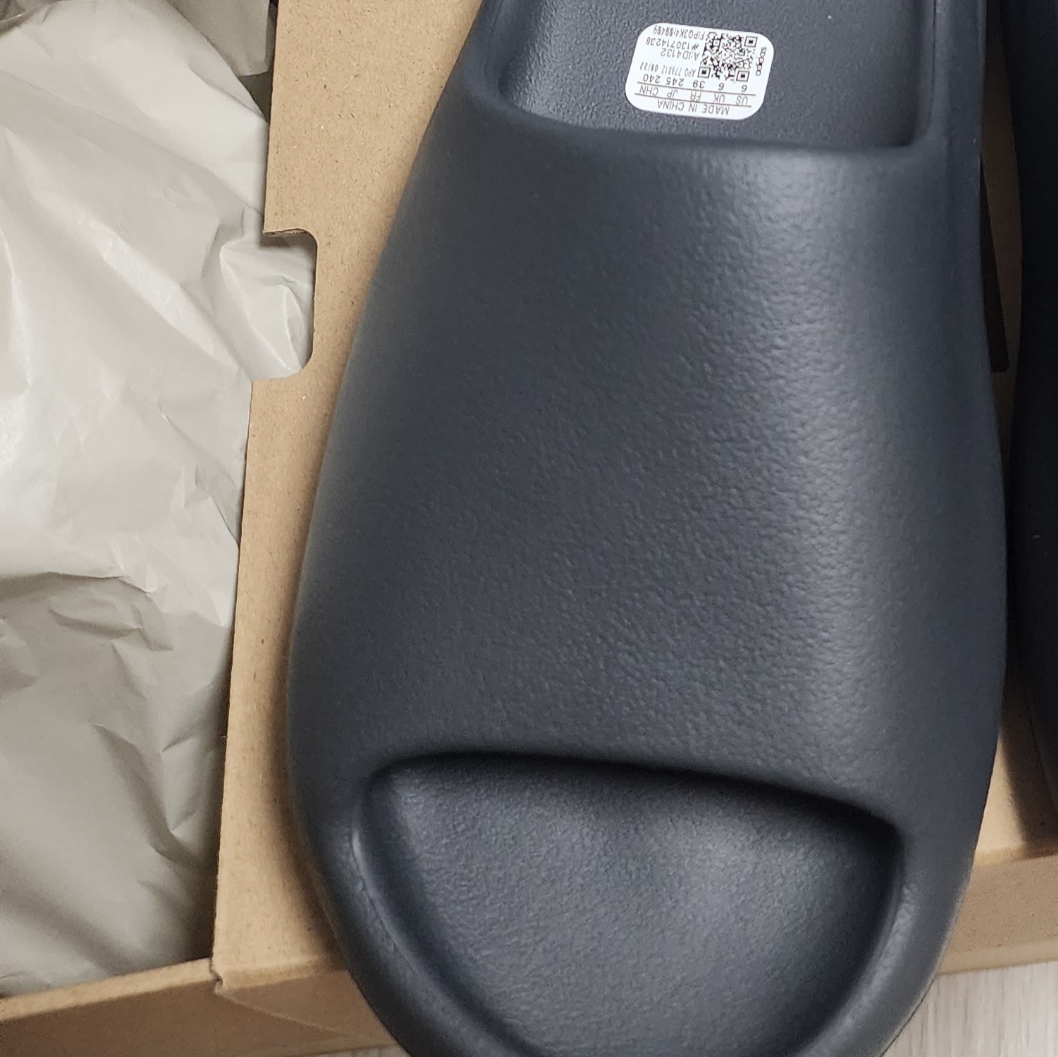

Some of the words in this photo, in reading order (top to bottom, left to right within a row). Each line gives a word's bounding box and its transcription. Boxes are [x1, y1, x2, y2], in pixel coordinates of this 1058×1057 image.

[642, 73, 661, 84] 240
[666, 77, 685, 87] 245
[692, 79, 706, 89] 39
[639, 85, 659, 97] CHN
[666, 89, 679, 99] JP
[690, 91, 702, 102] FR
[713, 93, 726, 103] UK
[735, 95, 749, 106] US
[657, 99, 685, 112] CHINA
[688, 104, 698, 113] IN
[702, 103, 730, 116] MADE
